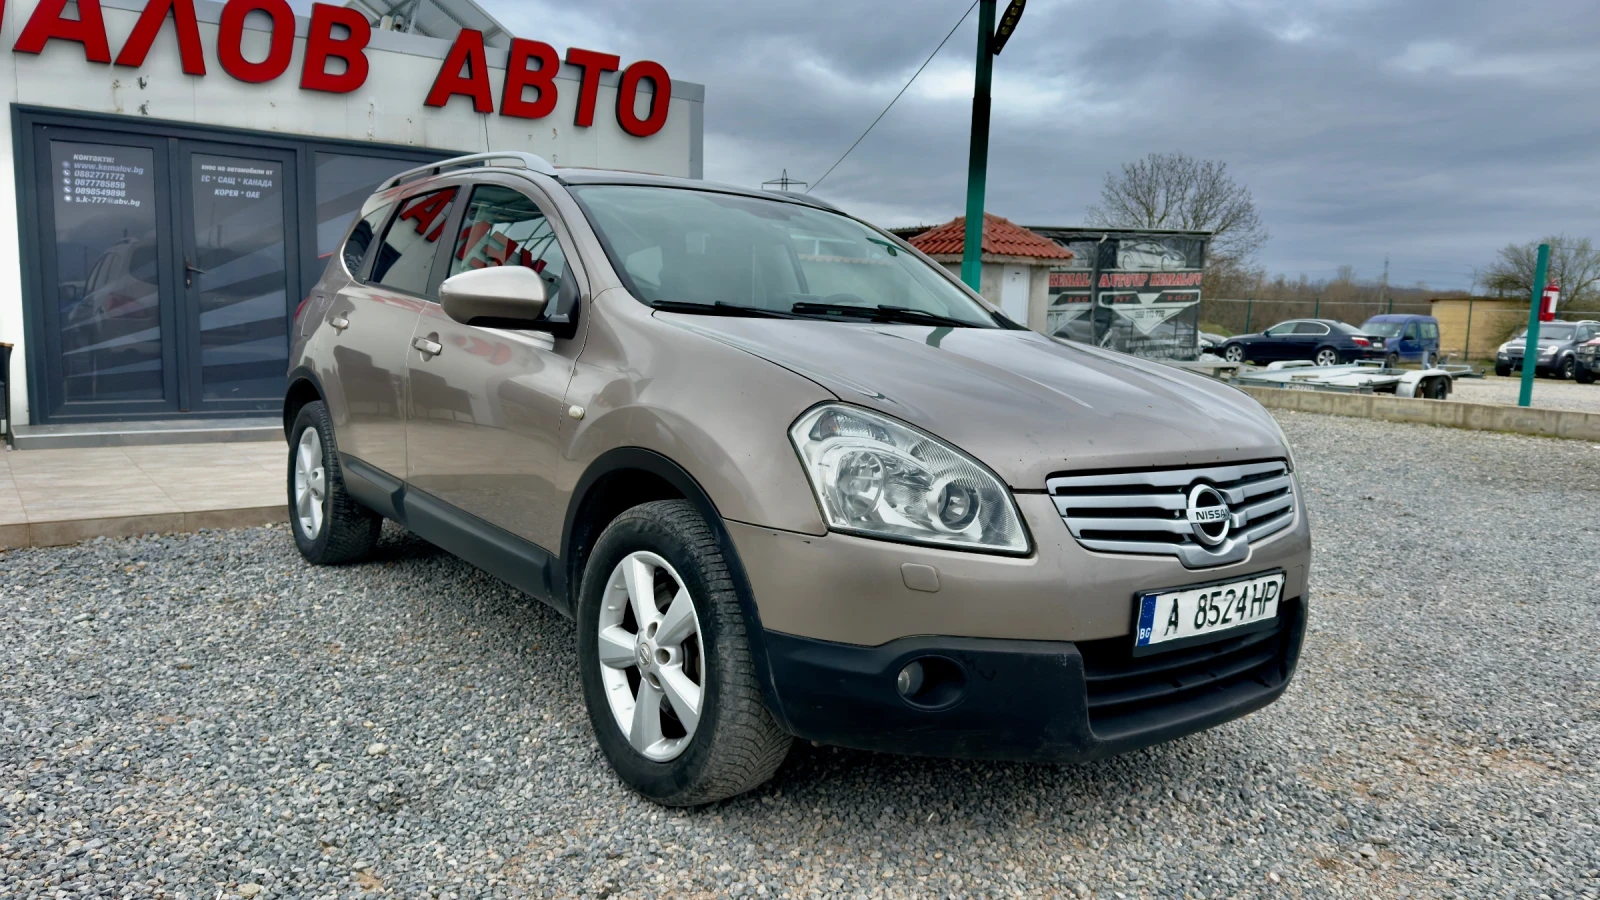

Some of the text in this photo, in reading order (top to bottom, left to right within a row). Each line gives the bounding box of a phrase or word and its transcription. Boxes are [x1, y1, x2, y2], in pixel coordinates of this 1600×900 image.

[0, 0, 671, 137] АЛОВ АВТО
[74, 163, 144, 175] www.kemalov.bg
[74, 170, 125, 181] 0882771772
[74, 179, 126, 189] 0877785859
[217, 176, 236, 185] САЩ
[243, 178, 273, 187] КАНАДА
[75, 187, 126, 198] 0898549898
[214, 189, 239, 197] КОРЕЯ
[1149, 272, 1203, 286] KEMALOV
[1195, 508, 1231, 521] NISSAN
[1139, 627, 1151, 640] BG
